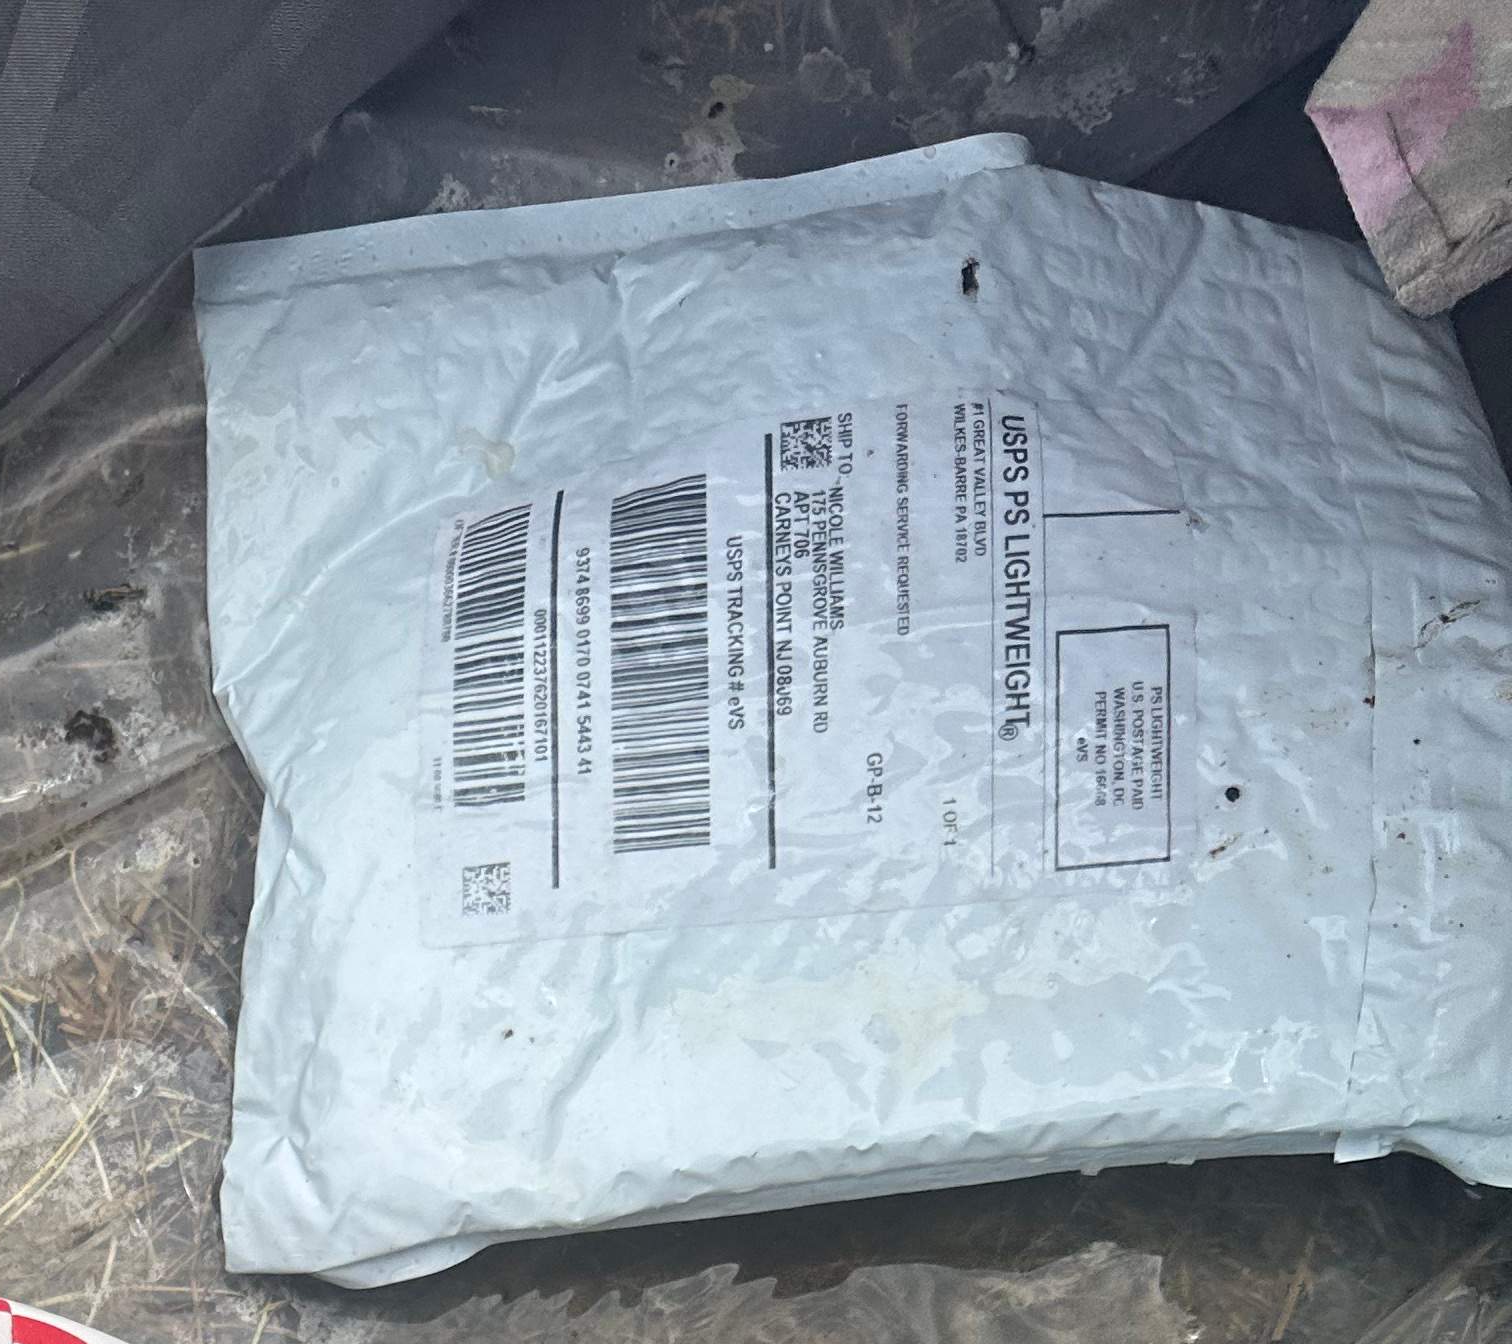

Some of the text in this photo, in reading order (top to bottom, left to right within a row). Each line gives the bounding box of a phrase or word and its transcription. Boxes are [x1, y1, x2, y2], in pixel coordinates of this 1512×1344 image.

[837, 412, 852, 449] SHIP
[972, 419, 986, 464] GREAT
[1001, 414, 1029, 483] USPS
[953, 403, 968, 564] WILKES-BARRE PA 18702
[973, 467, 987, 517] VALLEY
[1002, 490, 1030, 527] PS
[775, 492, 792, 576] CARNEYS
[793, 491, 810, 559] APT 706
[895, 404, 910, 636] FORWARDING SERVICE REQUESTED
[974, 520, 987, 557] BLVD
[829, 487, 845, 630] NICOLE WILLIAMS
[726, 535, 744, 730] USPS TRACKING # eVS
[775, 582, 792, 633] POINT
[811, 489, 829, 733] 175 PENNSGROVE AUBURN RD
[576, 547, 592, 775] 9374 8699 0170 0741 5443 41
[776, 640, 792, 661] NJ
[1095, 691, 1107, 741] PERMIT
[1131, 709, 1144, 775] POSTAGE
[1150, 686, 1163, 800] PS LIGHTWEIGHT
[867, 752, 883, 824] GP-B-12
[1131, 779, 1144, 810] PAID
[943, 797, 957, 847] 1 OF 1
